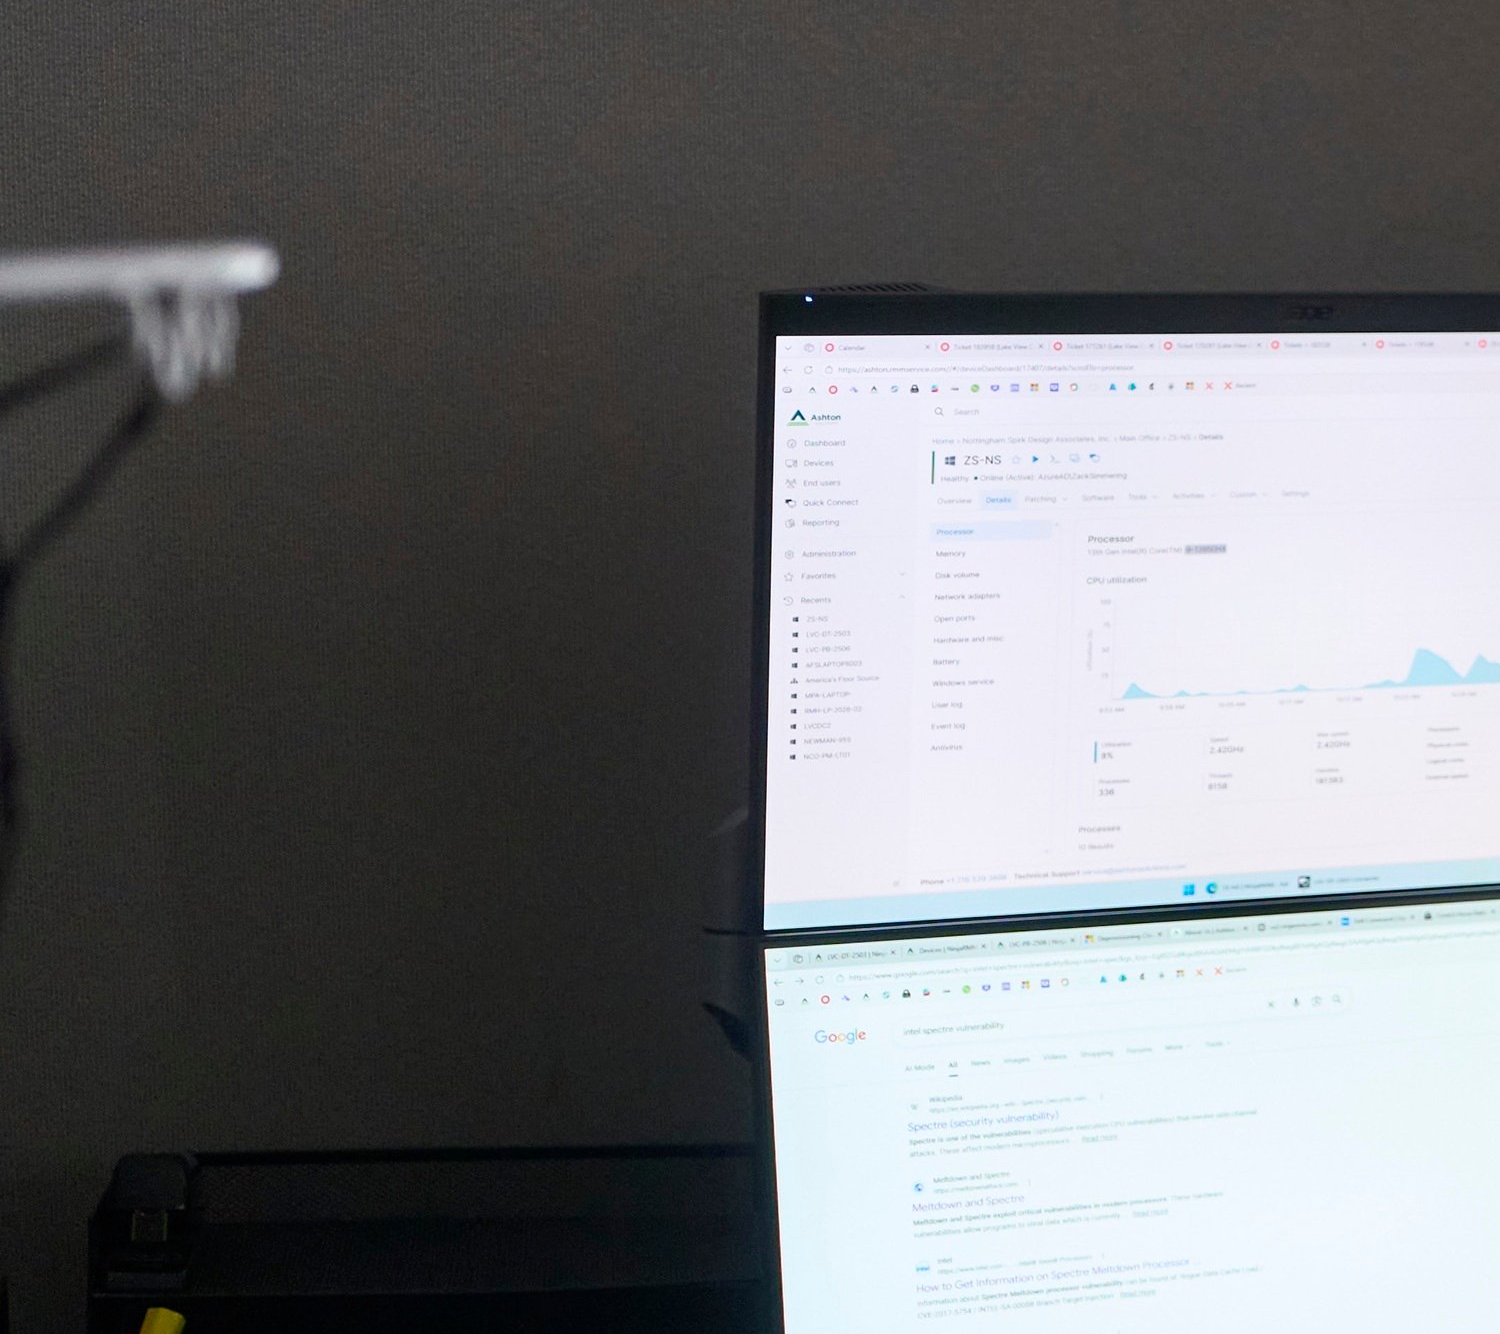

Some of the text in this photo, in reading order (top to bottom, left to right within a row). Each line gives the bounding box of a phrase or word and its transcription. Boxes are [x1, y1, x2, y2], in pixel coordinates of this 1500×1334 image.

[954, 408, 979, 416] Search
[804, 459, 834, 467] Devices
[964, 455, 1001, 465] ZS-NS
[986, 496, 1012, 504] Details
[1024, 495, 1056, 504] Patching
[802, 519, 839, 527] Reporting
[1088, 535, 1134, 543] Processor
[1086, 576, 1147, 585] CPU utilization
[955, 615, 975, 623] ports
[933, 636, 969, 644] Hardware
[923, 1027, 954, 1035] spectre
[956, 1022, 1004, 1032] vulnerability
[814, 1027, 867, 1045] Google
[1003, 1057, 1030, 1065] Images
[1080, 1050, 1114, 1058] Shopping
[908, 1108, 1059, 1133] Spectre (security vulnerability)
[909, 1138, 936, 1146] Spectre
[912, 1194, 1024, 1212] Meltdown and Spectre
[916, 1259, 1189, 1293] How to Get Information on Spectre Meltdown Processor
